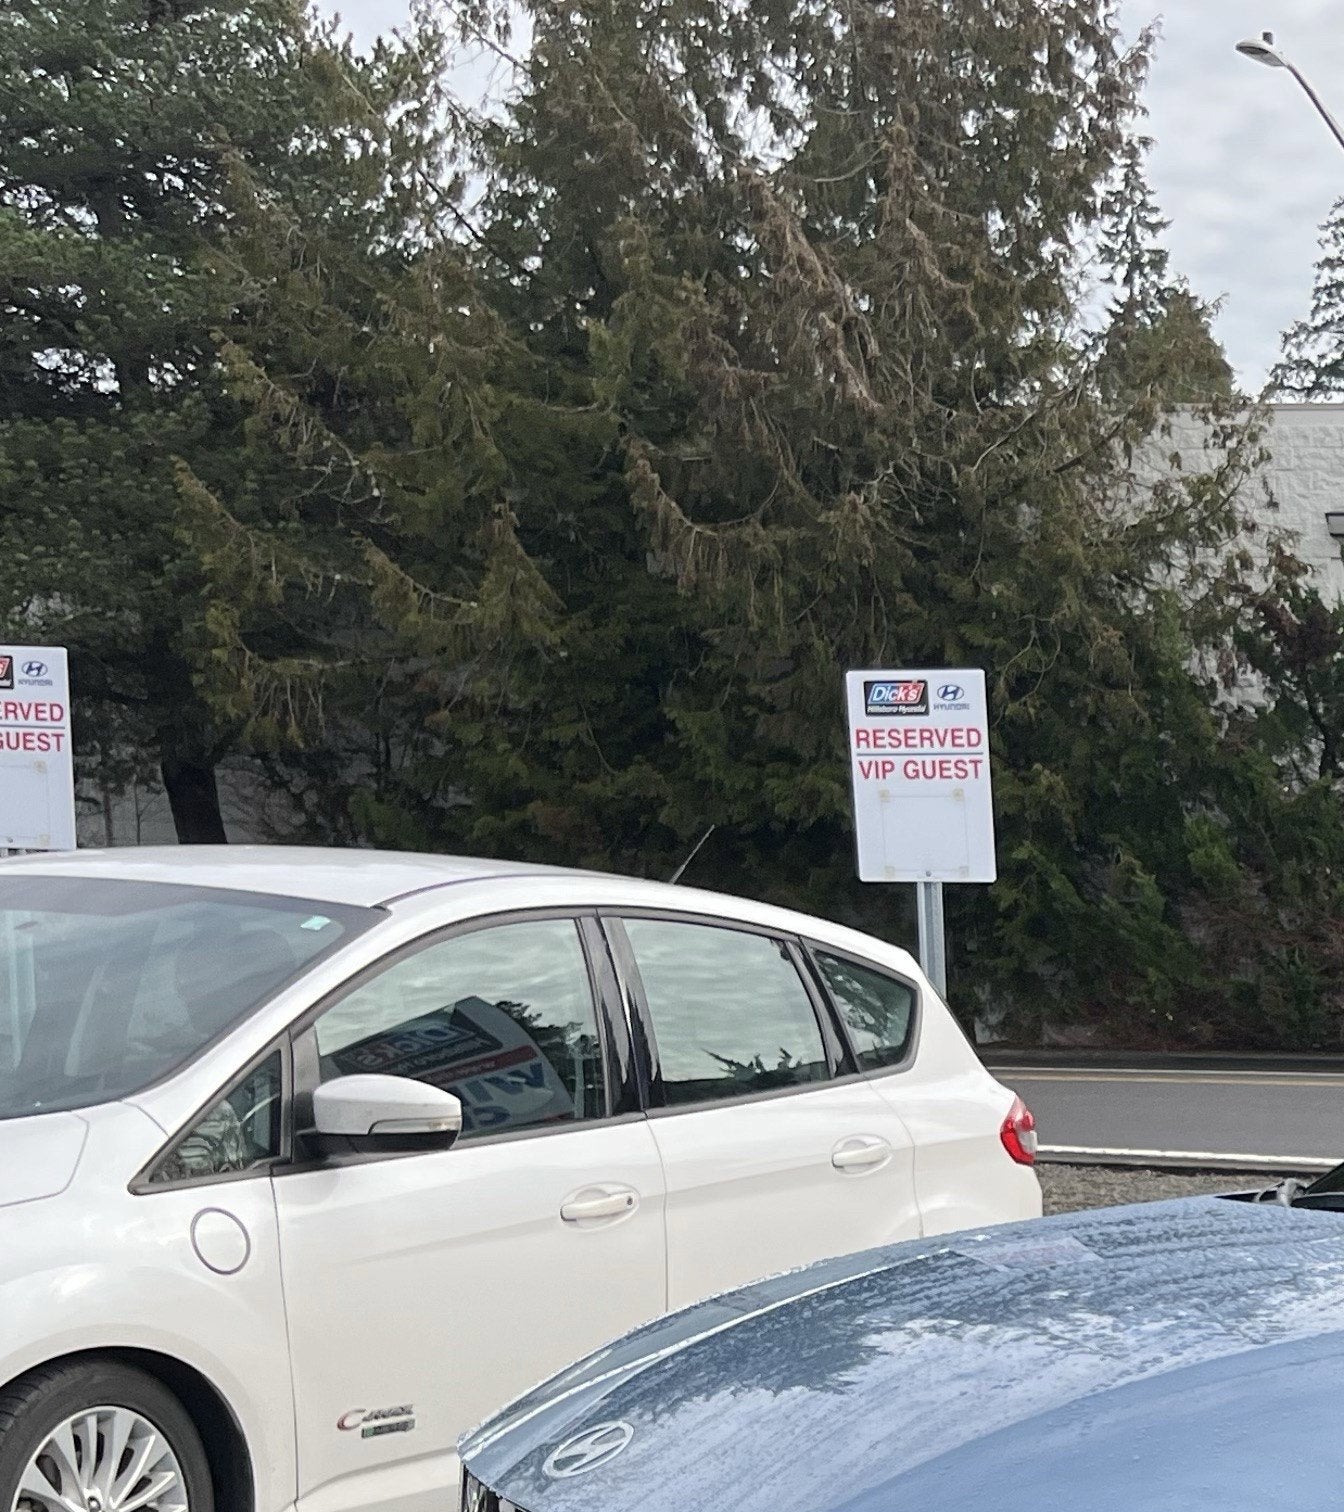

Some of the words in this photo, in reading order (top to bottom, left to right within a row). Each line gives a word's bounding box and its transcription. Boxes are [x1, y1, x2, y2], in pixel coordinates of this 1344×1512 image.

[872, 684, 919, 702] Dick's
[0, 702, 65, 722] RVED
[0, 732, 65, 752] UEST
[855, 728, 983, 749] RESERVED
[858, 760, 896, 780] VIP
[903, 759, 983, 780] GUEST
